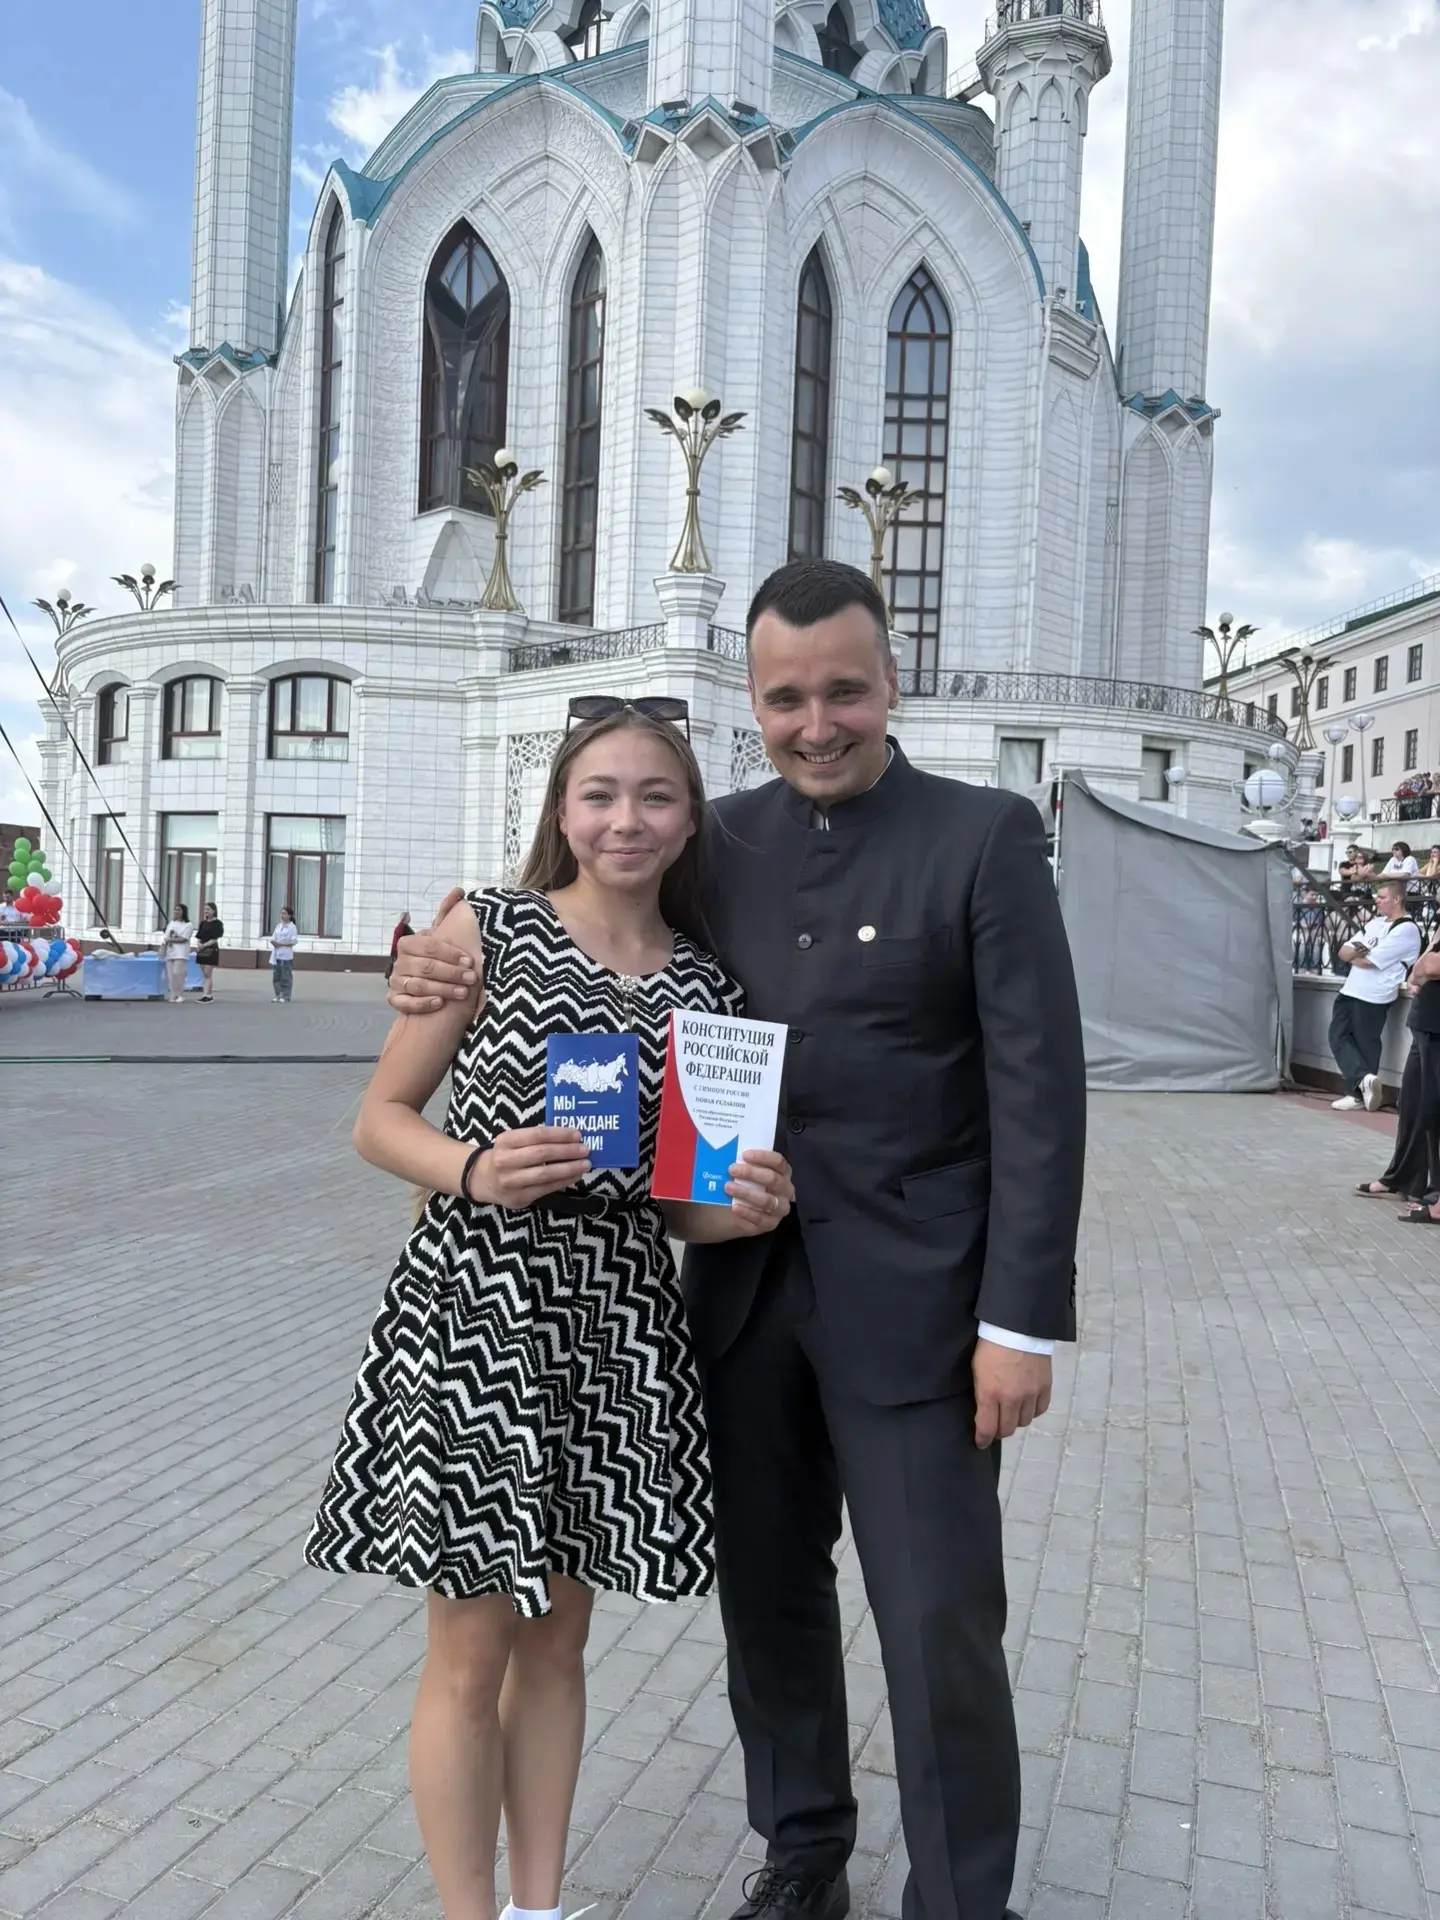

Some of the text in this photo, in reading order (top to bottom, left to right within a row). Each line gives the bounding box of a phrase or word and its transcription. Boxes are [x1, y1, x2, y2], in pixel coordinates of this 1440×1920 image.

[681, 1020, 775, 1047] КОНСТИТУЦИЯ
[683, 1041, 769, 1066] РОССИЙСКОЙ
[685, 1061, 762, 1085] ФЕДЕРАЦИИ
[553, 1095, 576, 1111] МЫ
[553, 1115, 620, 1131] ГРАЖДАНЕ
